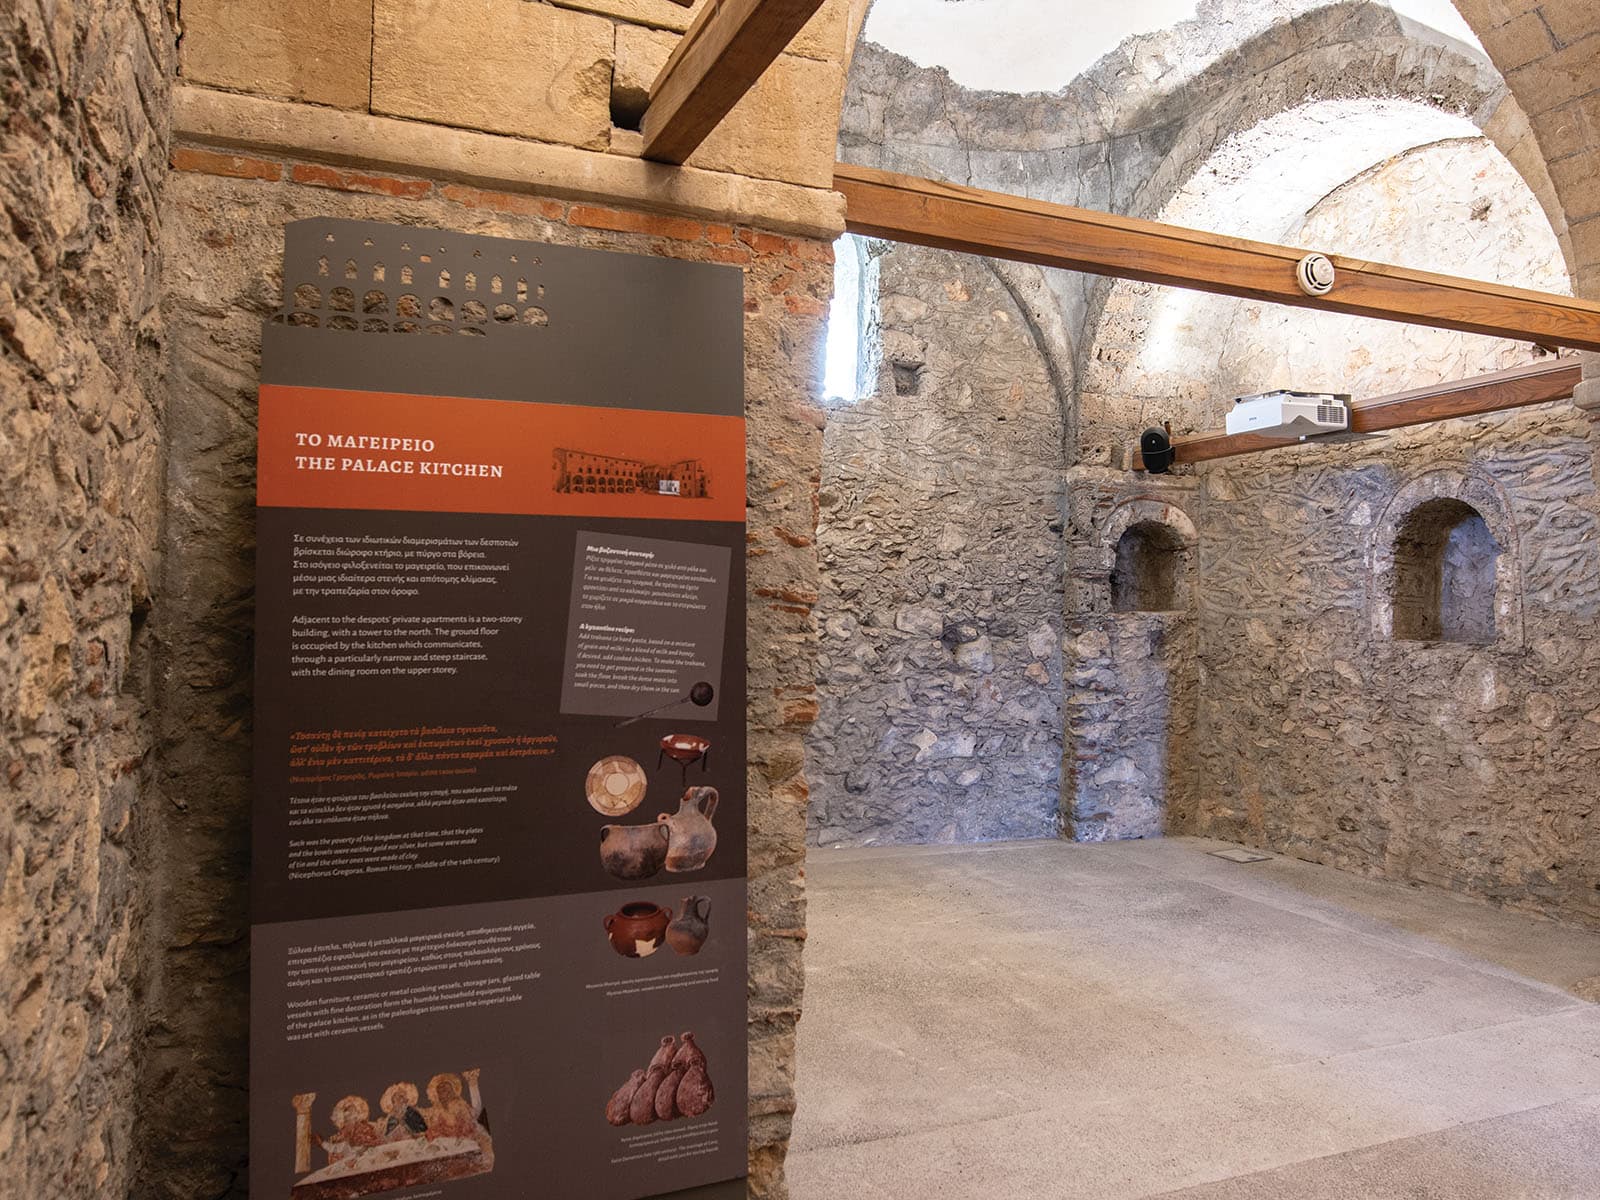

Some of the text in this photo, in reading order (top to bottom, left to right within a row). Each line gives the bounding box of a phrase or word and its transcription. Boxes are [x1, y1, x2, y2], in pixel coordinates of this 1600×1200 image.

[295, 433, 434, 452] ΤΟ ΜΑΓΕΙΡΕΙΟ
[295, 456, 503, 477] THE PALACE KITCHEN
[292, 614, 330, 625] Adjacent
[331, 614, 340, 623] to
[341, 614, 356, 623] the
[392, 614, 420, 625] private
[421, 614, 467, 624] apartments
[468, 614, 475, 622] is
[481, 614, 522, 624] two-storey
[331, 627, 350, 636] with
[358, 627, 382, 636] tower
[383, 627, 392, 635] to
[393, 627, 407, 635] the
[434, 626, 449, 635] The
[450, 626, 479, 637] ground
[480, 626, 499, 635] floor
[291, 640, 298, 649] is
[299, 640, 338, 651] occupied
[339, 640, 350, 651] by
[351, 640, 365, 649] the
[366, 640, 397, 648] kitchen
[398, 639, 422, 648] which
[291, 653, 326, 664] through
[334, 653, 381, 664] particularly
[412, 652, 428, 661] and
[429, 652, 451, 663] steep
[291, 666, 310, 675] with
[312, 666, 326, 675] the
[327, 666, 355, 677] dining
[392, 665, 406, 674] the
[406, 668, 431, 676] upper
